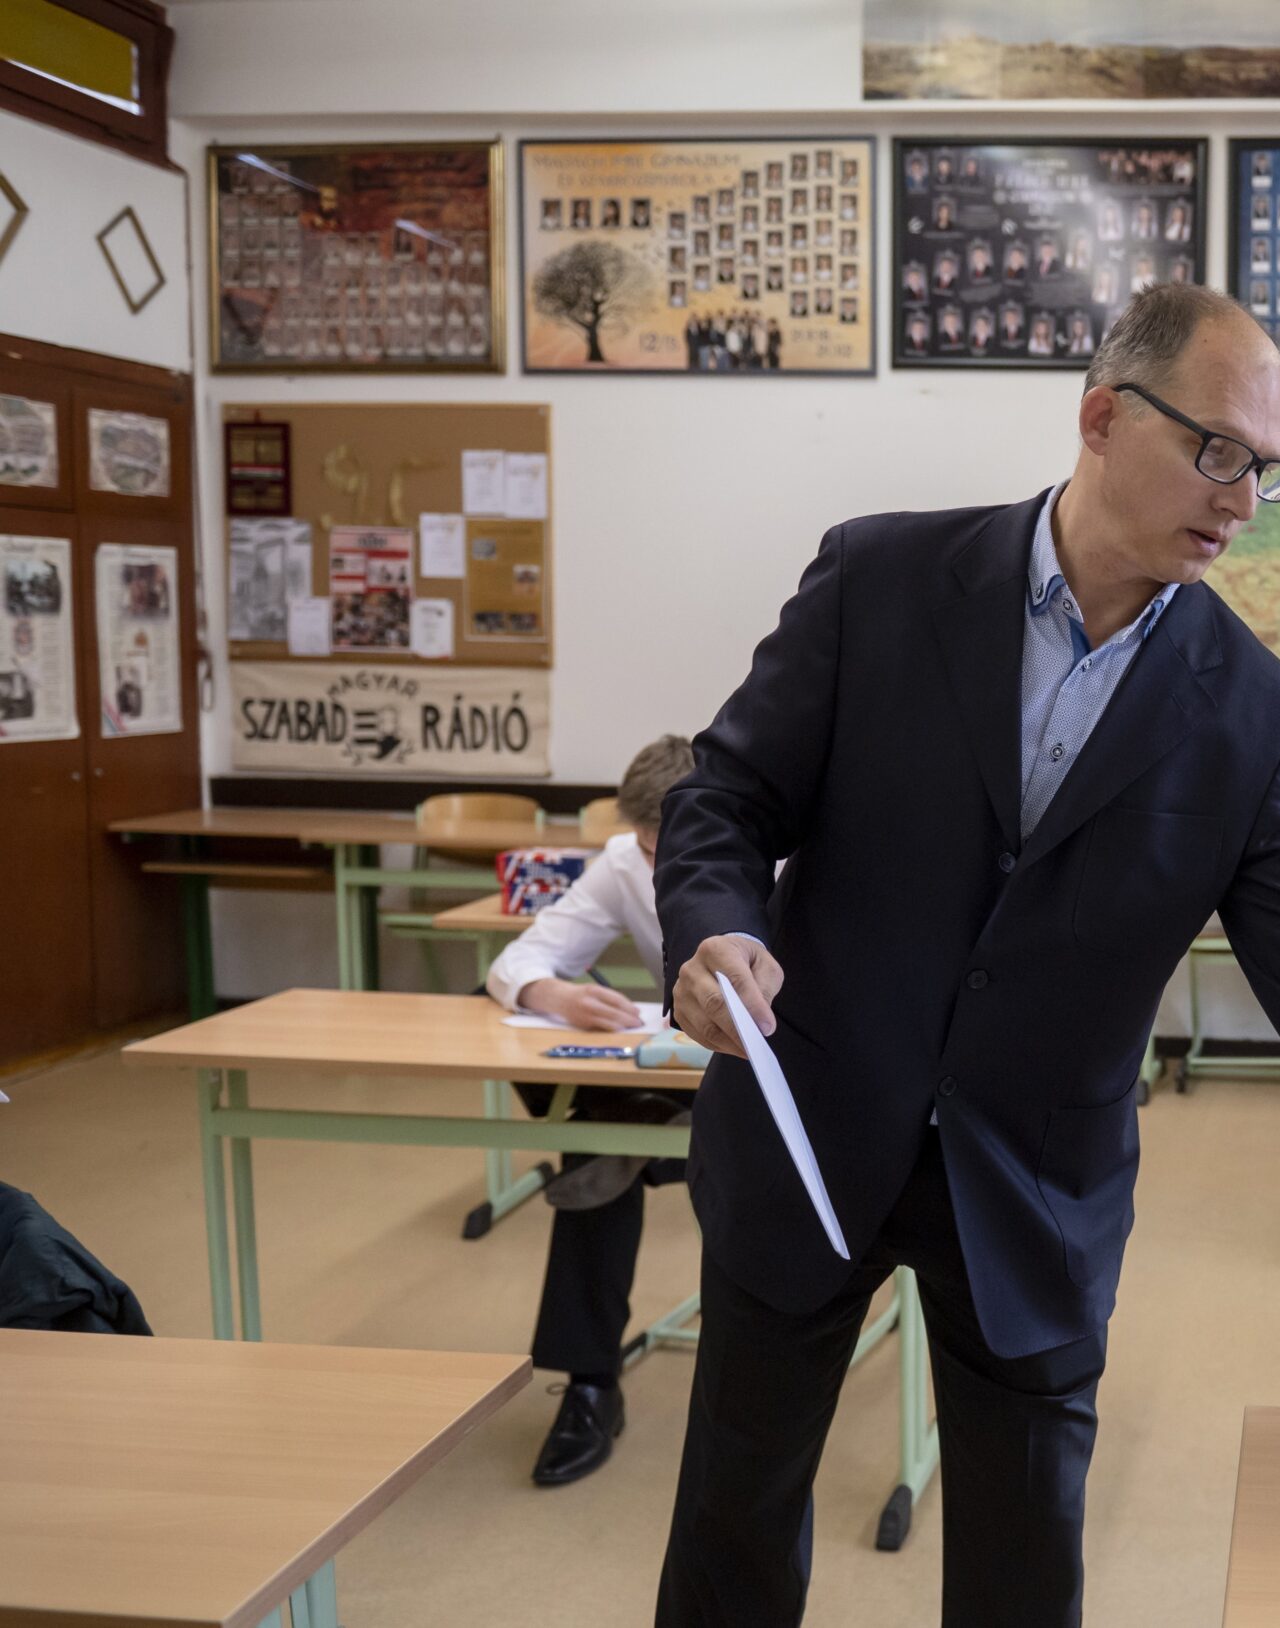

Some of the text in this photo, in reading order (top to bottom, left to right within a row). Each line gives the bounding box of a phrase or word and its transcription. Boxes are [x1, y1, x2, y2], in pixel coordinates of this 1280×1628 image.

[327, 670, 420, 700] MAGYAR
[242, 690, 530, 754] SZABAD RÁDIÓ
